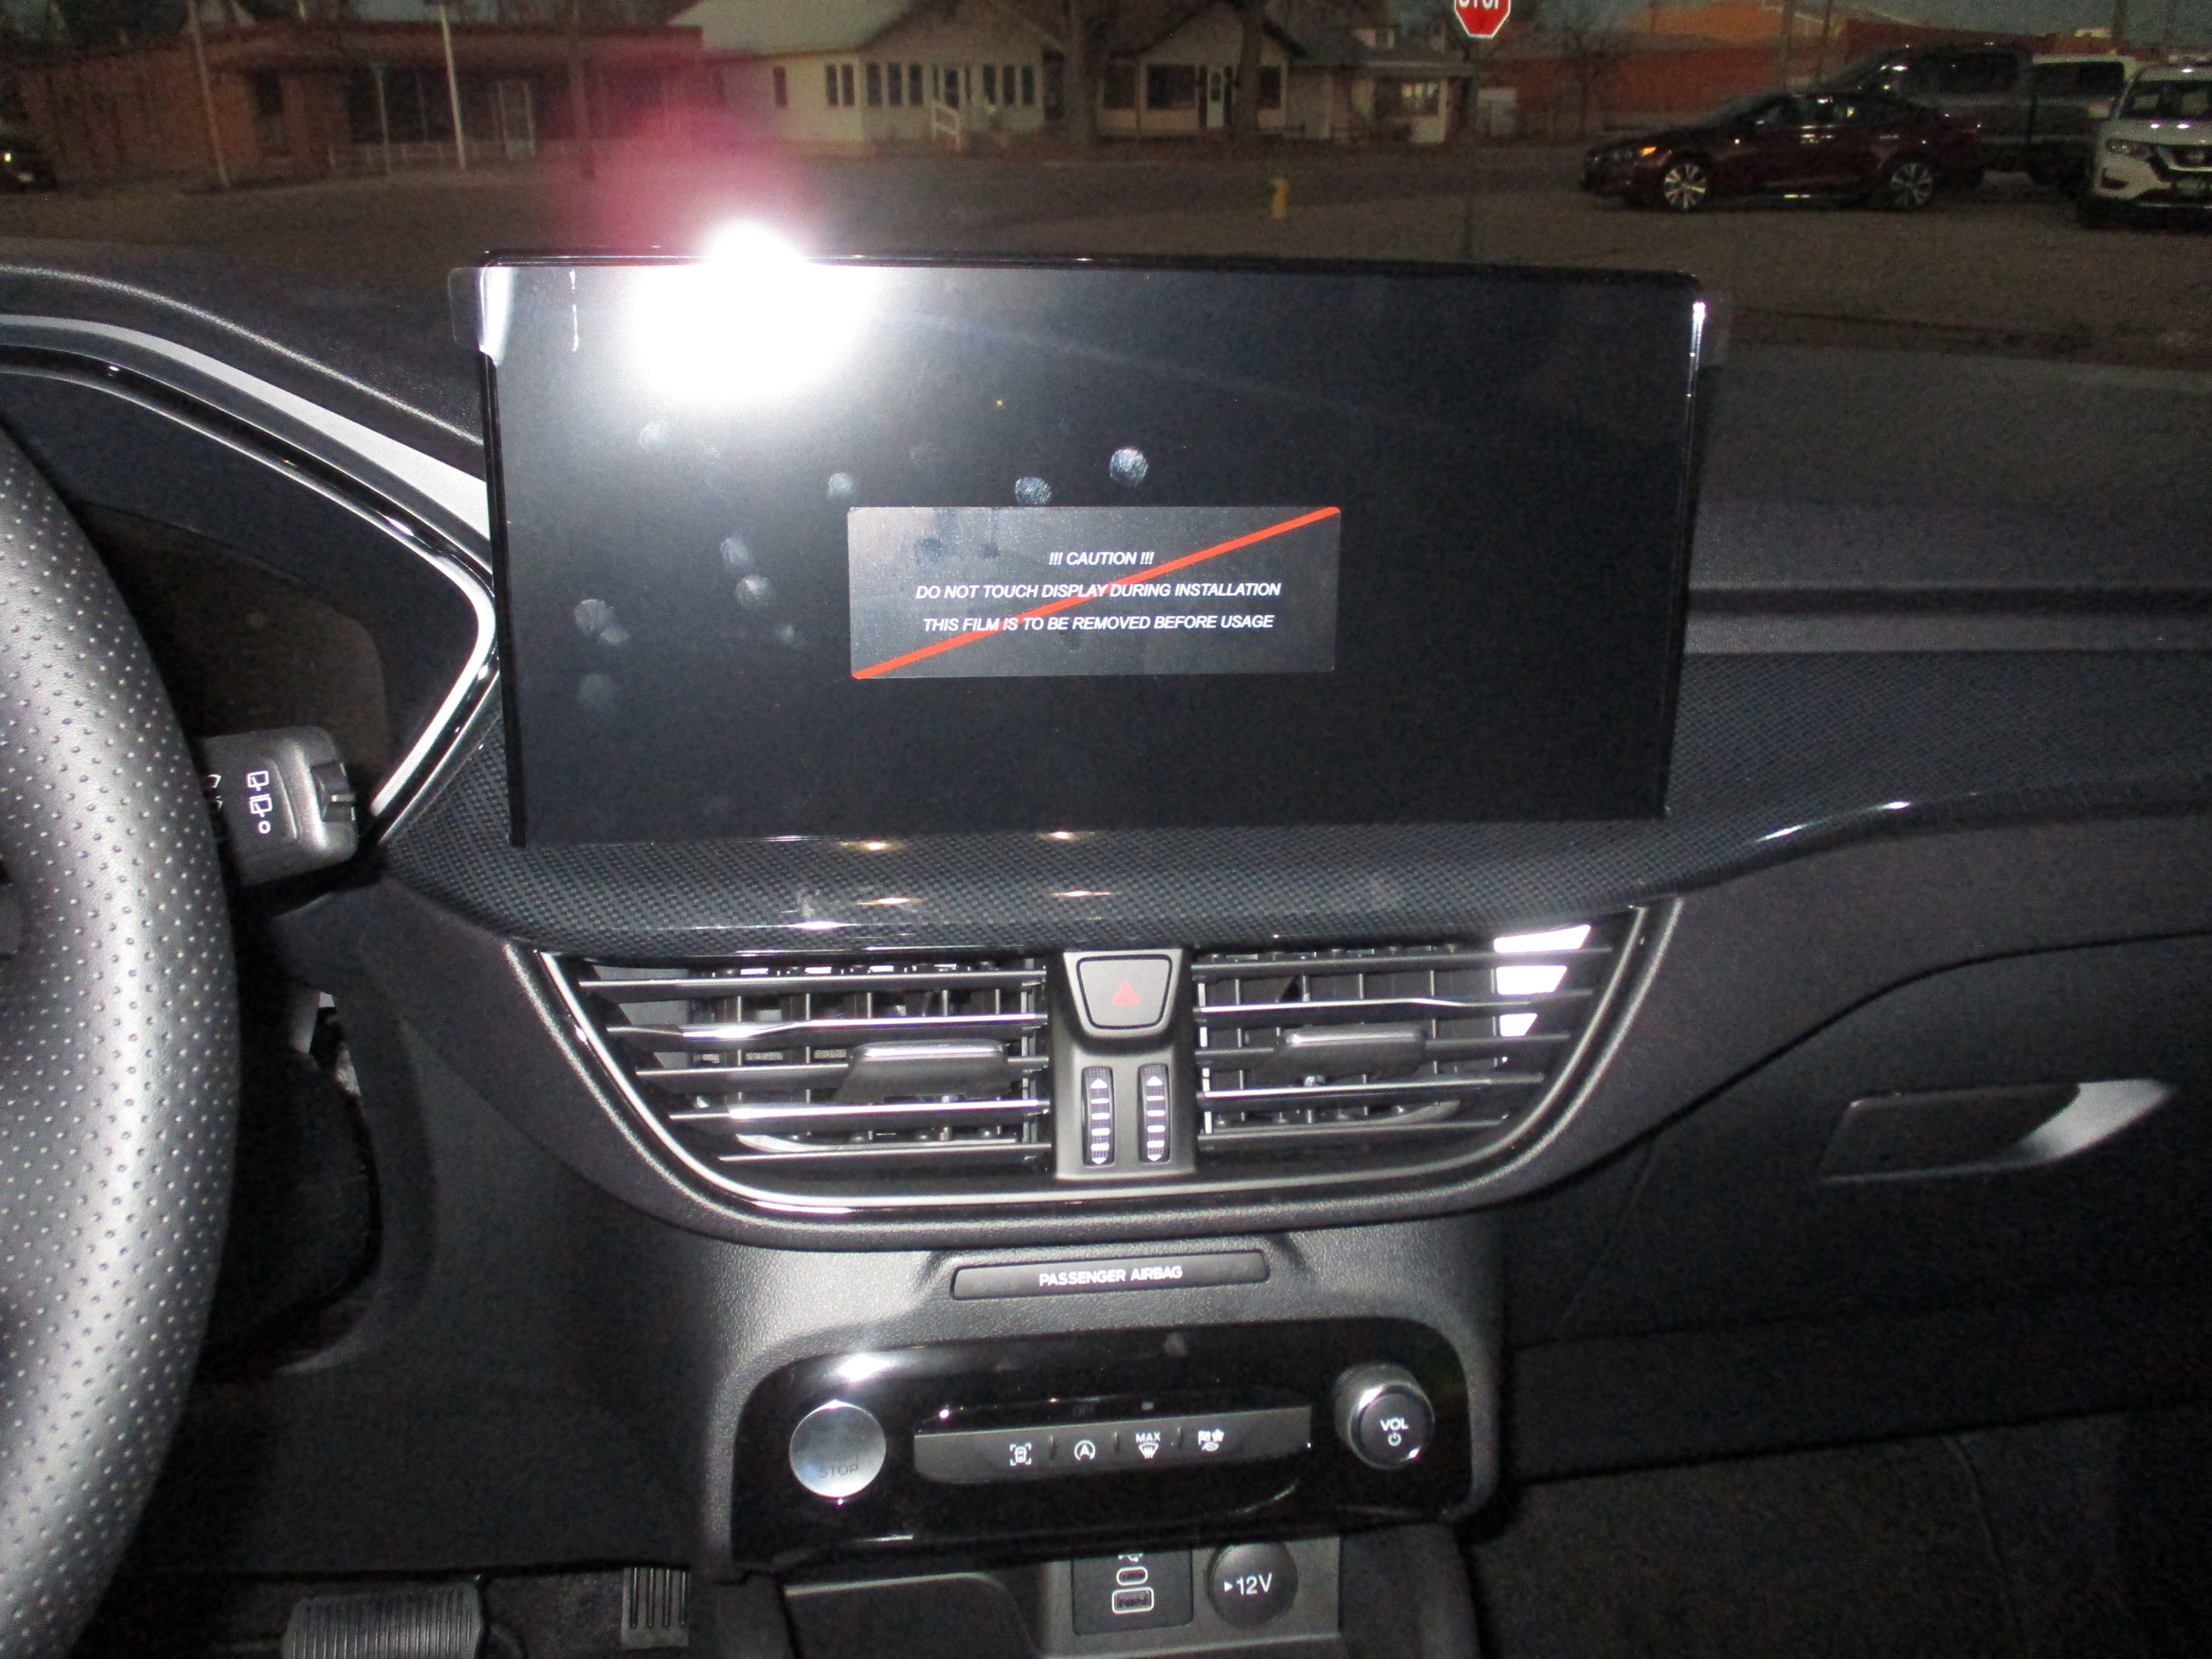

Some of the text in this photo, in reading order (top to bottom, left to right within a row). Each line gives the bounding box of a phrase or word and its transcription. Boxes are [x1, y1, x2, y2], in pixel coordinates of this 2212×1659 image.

[1066, 551, 1137, 565] CAUTION
[916, 583, 1282, 599] DO NOT TOUCH DISPLAY DURING INSTALLATION
[923, 615, 1274, 631] THIS FILM IS TO BE REMOVED BEFORE USAGE
[1039, 1265, 1183, 1286] PASSENGER AIRBAG
[1380, 1417, 1409, 1431] VOL
[1135, 1431, 1161, 1444] MAX
[817, 1463, 859, 1479] STOP
[1236, 1573, 1272, 1595] 12V
